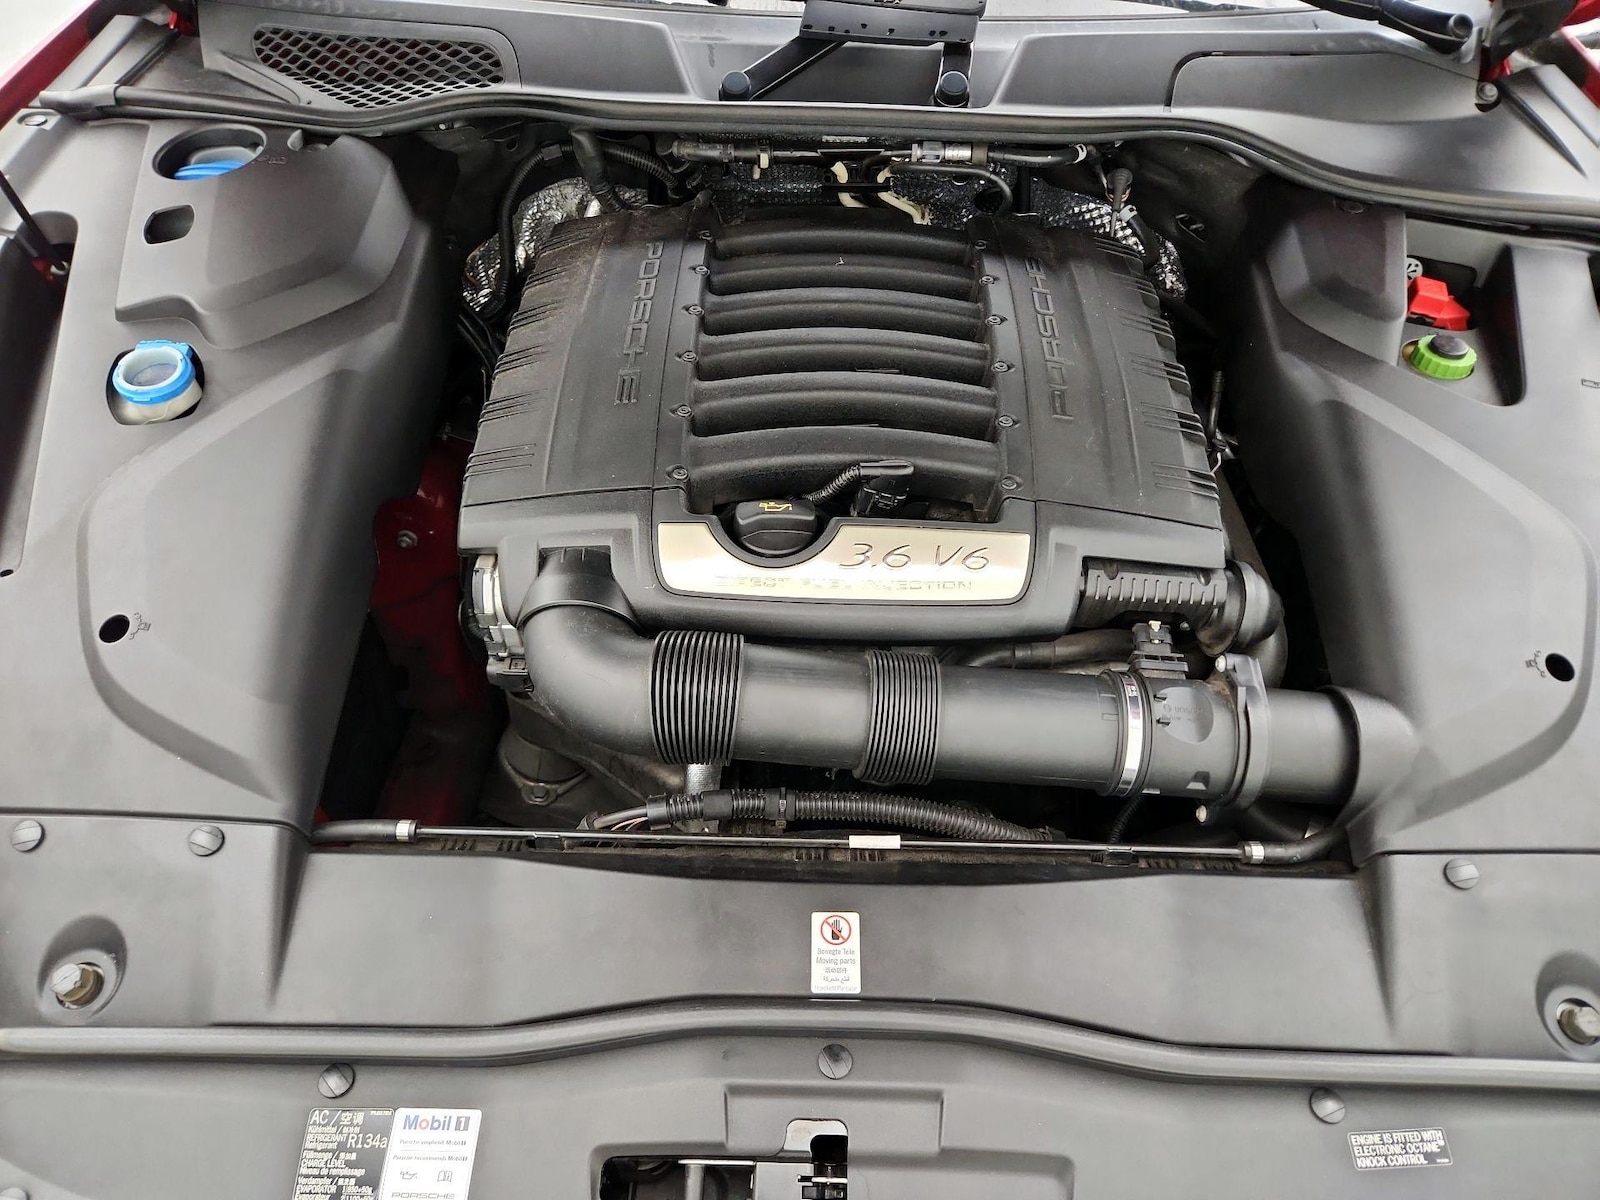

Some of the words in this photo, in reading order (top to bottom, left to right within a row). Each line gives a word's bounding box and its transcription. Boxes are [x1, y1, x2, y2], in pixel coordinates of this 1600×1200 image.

[614, 240, 664, 405] PORSCHE
[1025, 257, 1074, 419] PORSCHE
[839, 543, 911, 568] 3.6
[935, 544, 990, 570] V6
[816, 957, 838, 965] Moving
[310, 1110, 329, 1124] AC
[403, 1115, 452, 1131] Mobil
[307, 1133, 347, 1142] REFRIGERANT
[347, 1133, 388, 1148] R134a
[1350, 1134, 1383, 1146] ENGINE
[1383, 1133, 1393, 1144] IS
[1392, 1131, 1421, 1143] FITTED
[1421, 1130, 1443, 1142] WITH
[1354, 1144, 1405, 1156] ELECTRONIC
[1406, 1142, 1440, 1153] OCTANE
[301, 1159, 326, 1168] CHARGE
[327, 1159, 346, 1168] LEVEL
[1356, 1156, 1388, 1168] KNOCK
[1387, 1154, 1428, 1166] CONTROL
[296, 1185, 337, 1194] EVAPORATOR
[391, 1192, 456, 1200] PORSCHE
